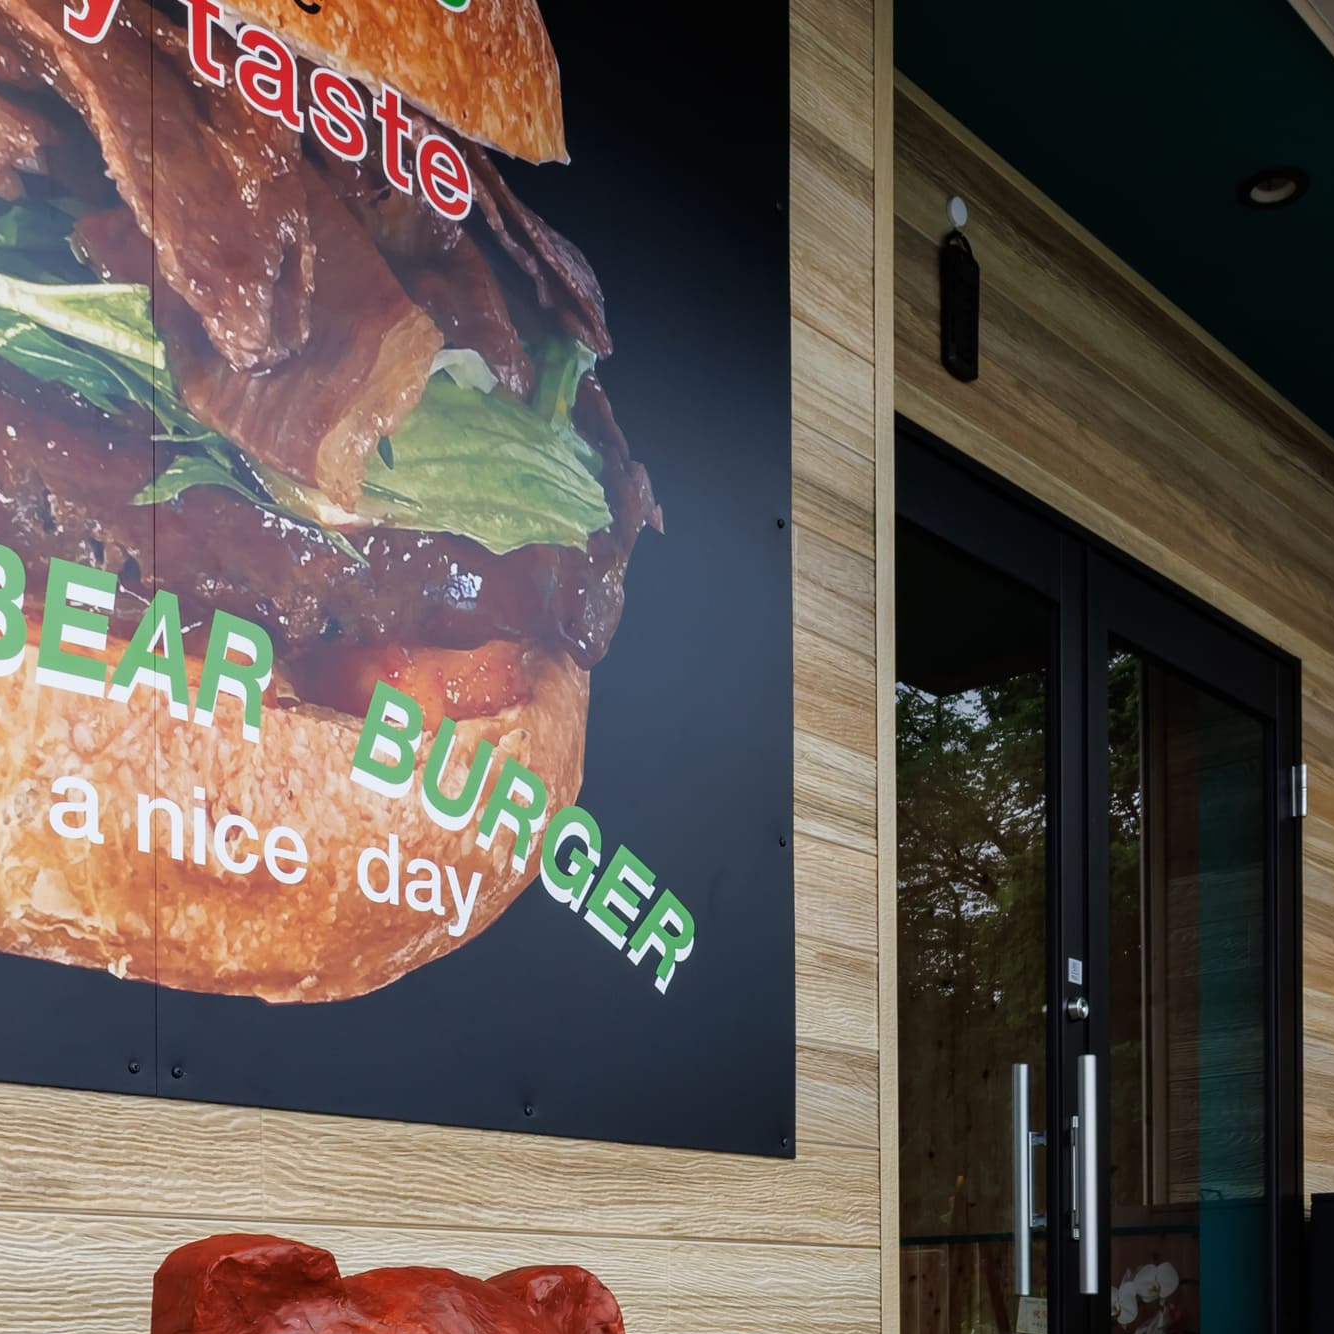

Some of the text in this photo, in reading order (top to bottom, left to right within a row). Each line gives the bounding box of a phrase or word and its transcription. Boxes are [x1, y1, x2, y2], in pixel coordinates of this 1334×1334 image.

[181, 0, 472, 221] taste
[47, 774, 104, 845] a
[136, 785, 310, 885] nice
[357, 832, 483, 937] day
[349, 679, 696, 995] BURGER
